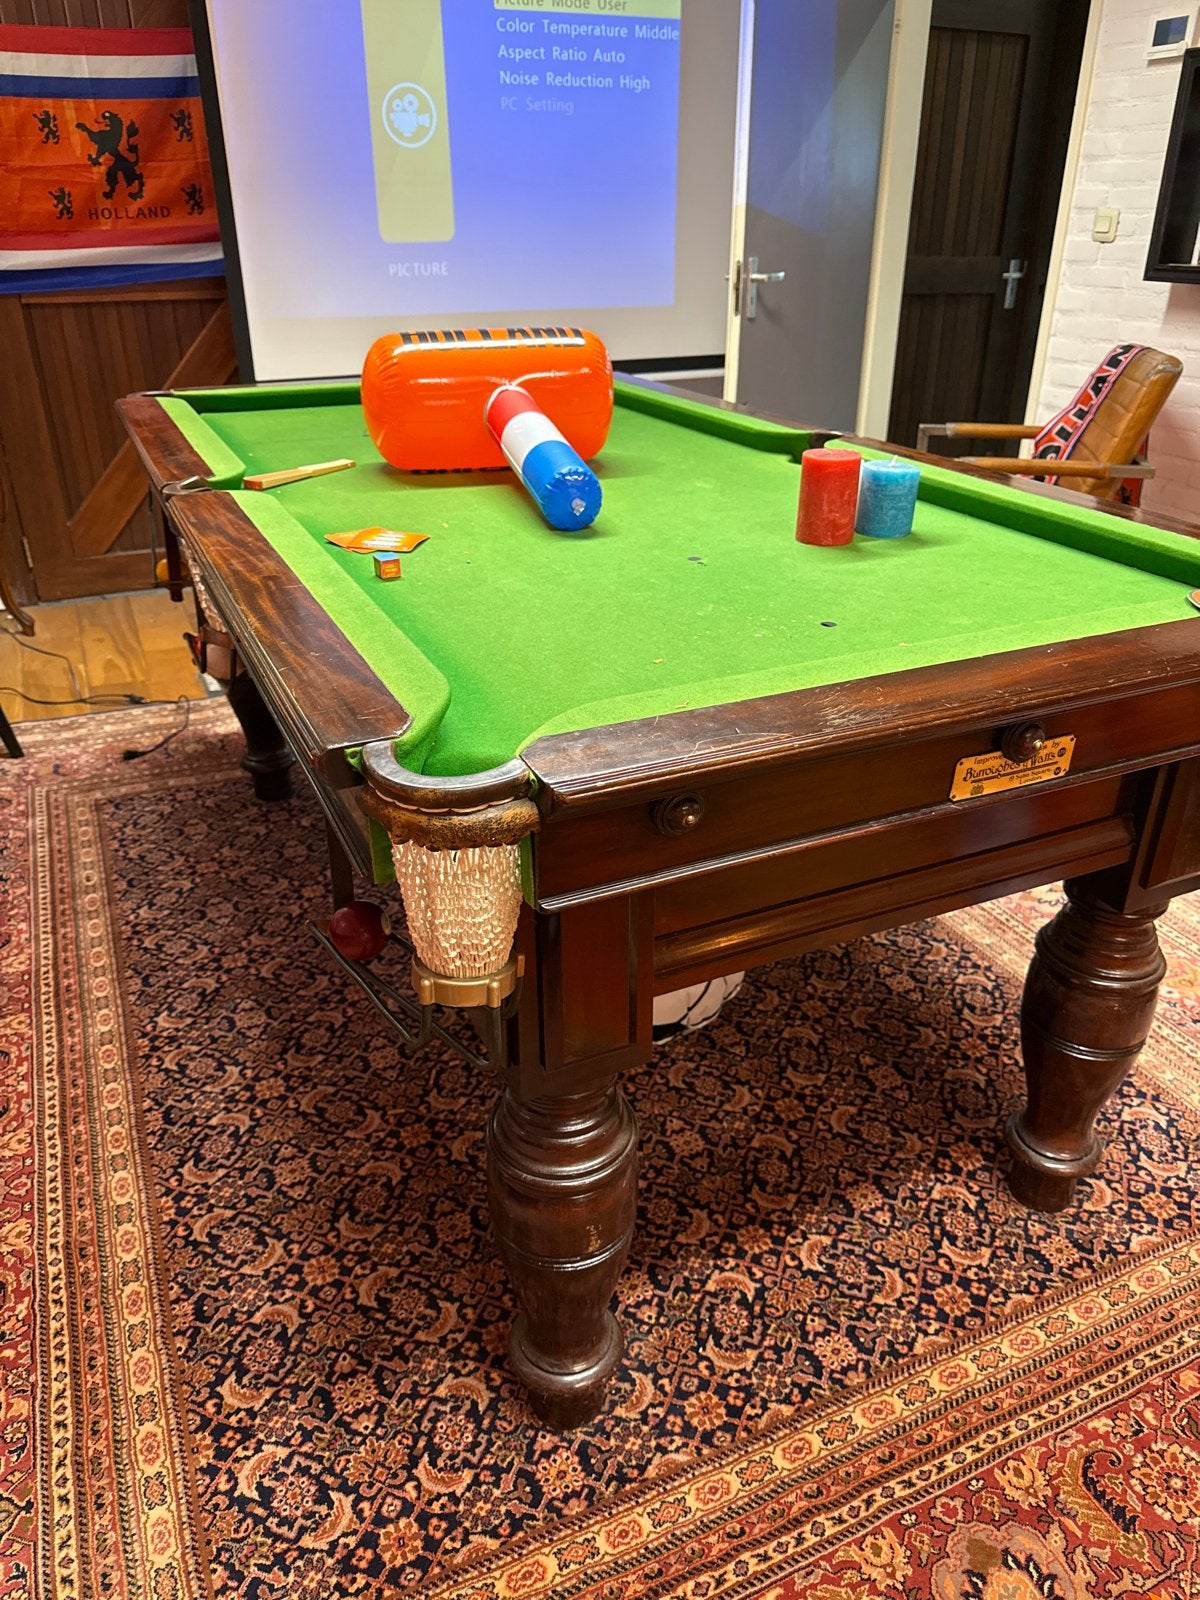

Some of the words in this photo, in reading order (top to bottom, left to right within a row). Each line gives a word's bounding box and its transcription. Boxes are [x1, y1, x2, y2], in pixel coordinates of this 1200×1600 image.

[597, 0, 628, 11] User
[496, 17, 535, 33] Color
[542, 19, 628, 38] Temperature
[635, 24, 679, 41] Middle
[498, 44, 545, 62] Aspect
[552, 46, 587, 62] Ratio
[593, 48, 626, 63] Auto
[499, 70, 540, 86] Noise
[546, 72, 613, 89] Reduction
[619, 75, 651, 94] High
[500, 96, 518, 111] PC
[526, 97, 575, 116] Setting
[88, 206, 171, 221] HOLLAND
[388, 261, 449, 277] PICTURE
[1034, 343, 1137, 483] OLLAN
